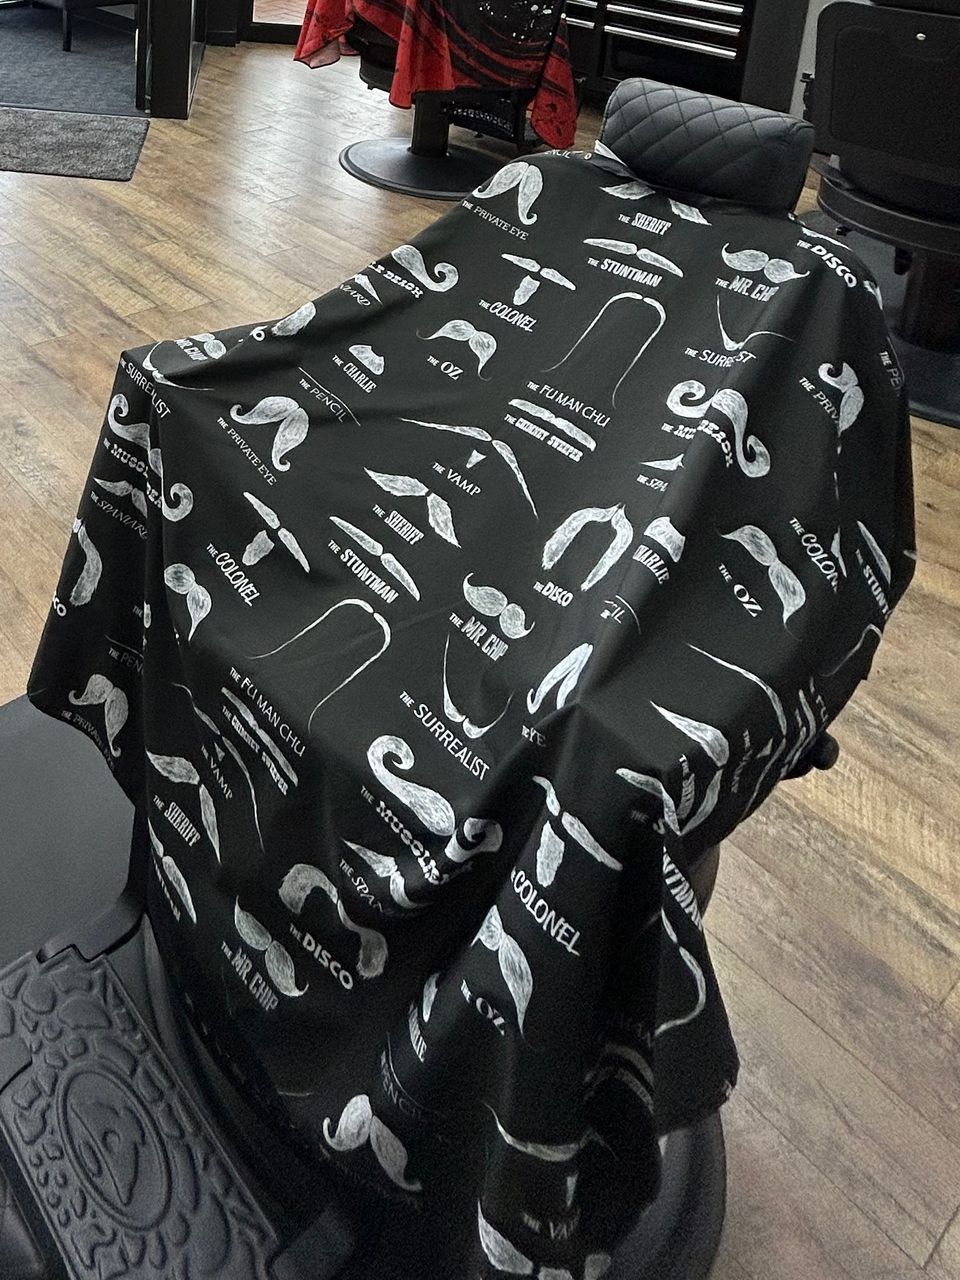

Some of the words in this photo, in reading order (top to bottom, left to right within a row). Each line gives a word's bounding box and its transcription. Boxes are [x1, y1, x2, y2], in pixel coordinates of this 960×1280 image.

[462, 200, 473, 210] THE
[473, 206, 510, 231] PRIVATE
[508, 226, 529, 241] EYE
[618, 214, 630, 223] THE
[631, 212, 672, 236] SHERIFF
[587, 257, 599, 267] THE
[600, 258, 663, 288] STUNTMAN
[796, 239, 811, 249] THE
[810, 244, 857, 288] DISCO
[715, 278, 729, 288] THE
[728, 275, 750, 296] MR.
[479, 299, 490, 310] THE
[489, 301, 537, 333] COLONEL
[427, 355, 440, 367] THE
[440, 361, 464, 381] OZ
[684, 347, 698, 358] THE
[332, 355, 344, 367] THE
[342, 362, 377, 394] CHARLIE
[799, 377, 814, 392] THE
[299, 378, 311, 390] THE
[310, 387, 350, 423] PENCIL
[527, 381, 539, 392] THE
[539, 384, 559, 401] FU
[555, 392, 583, 414] MAN
[581, 407, 611, 429] CHU
[216, 417, 228, 430] THE
[227, 428, 261, 466] PRIVATE
[258, 463, 277, 486] EYE
[504, 413, 516, 425] THE
[547, 436, 583, 462] SWEEPER
[432, 462, 445, 474] THE
[447, 468, 481, 496] VAMP
[373, 504, 386, 518] THE
[384, 510, 425, 545] SHERIFF
[789, 517, 805, 536] THE
[206, 543, 219, 558] THE
[215, 551, 260, 607] COLONEL
[328, 539, 341, 554] THE
[340, 548, 399, 604] STUNTMAN
[718, 562, 733, 583] THE
[733, 584, 764, 618] OZ
[542, 581, 574, 607] DISCO
[449, 612, 464, 628] THE
[461, 616, 488, 647] MR.
[481, 633, 510, 662] CHIP
[229, 666, 241, 683] THE
[240, 677, 258, 701] FU
[256, 694, 281, 728] MAN
[279, 723, 306, 757] CHU
[399, 690, 415, 708] THE
[413, 703, 490, 781] SURREALIST
[210, 757, 233, 800] VAMP
[360, 785, 374, 805] THE
[152, 794, 166, 811] THE
[164, 801, 201, 847] SHERIFF
[339, 858, 354, 877] THE
[514, 870, 580, 957] COLONEL
[221, 940, 234, 960] THE
[248, 972, 279, 1012] CHIP
[302, 932, 354, 990] DISCO
